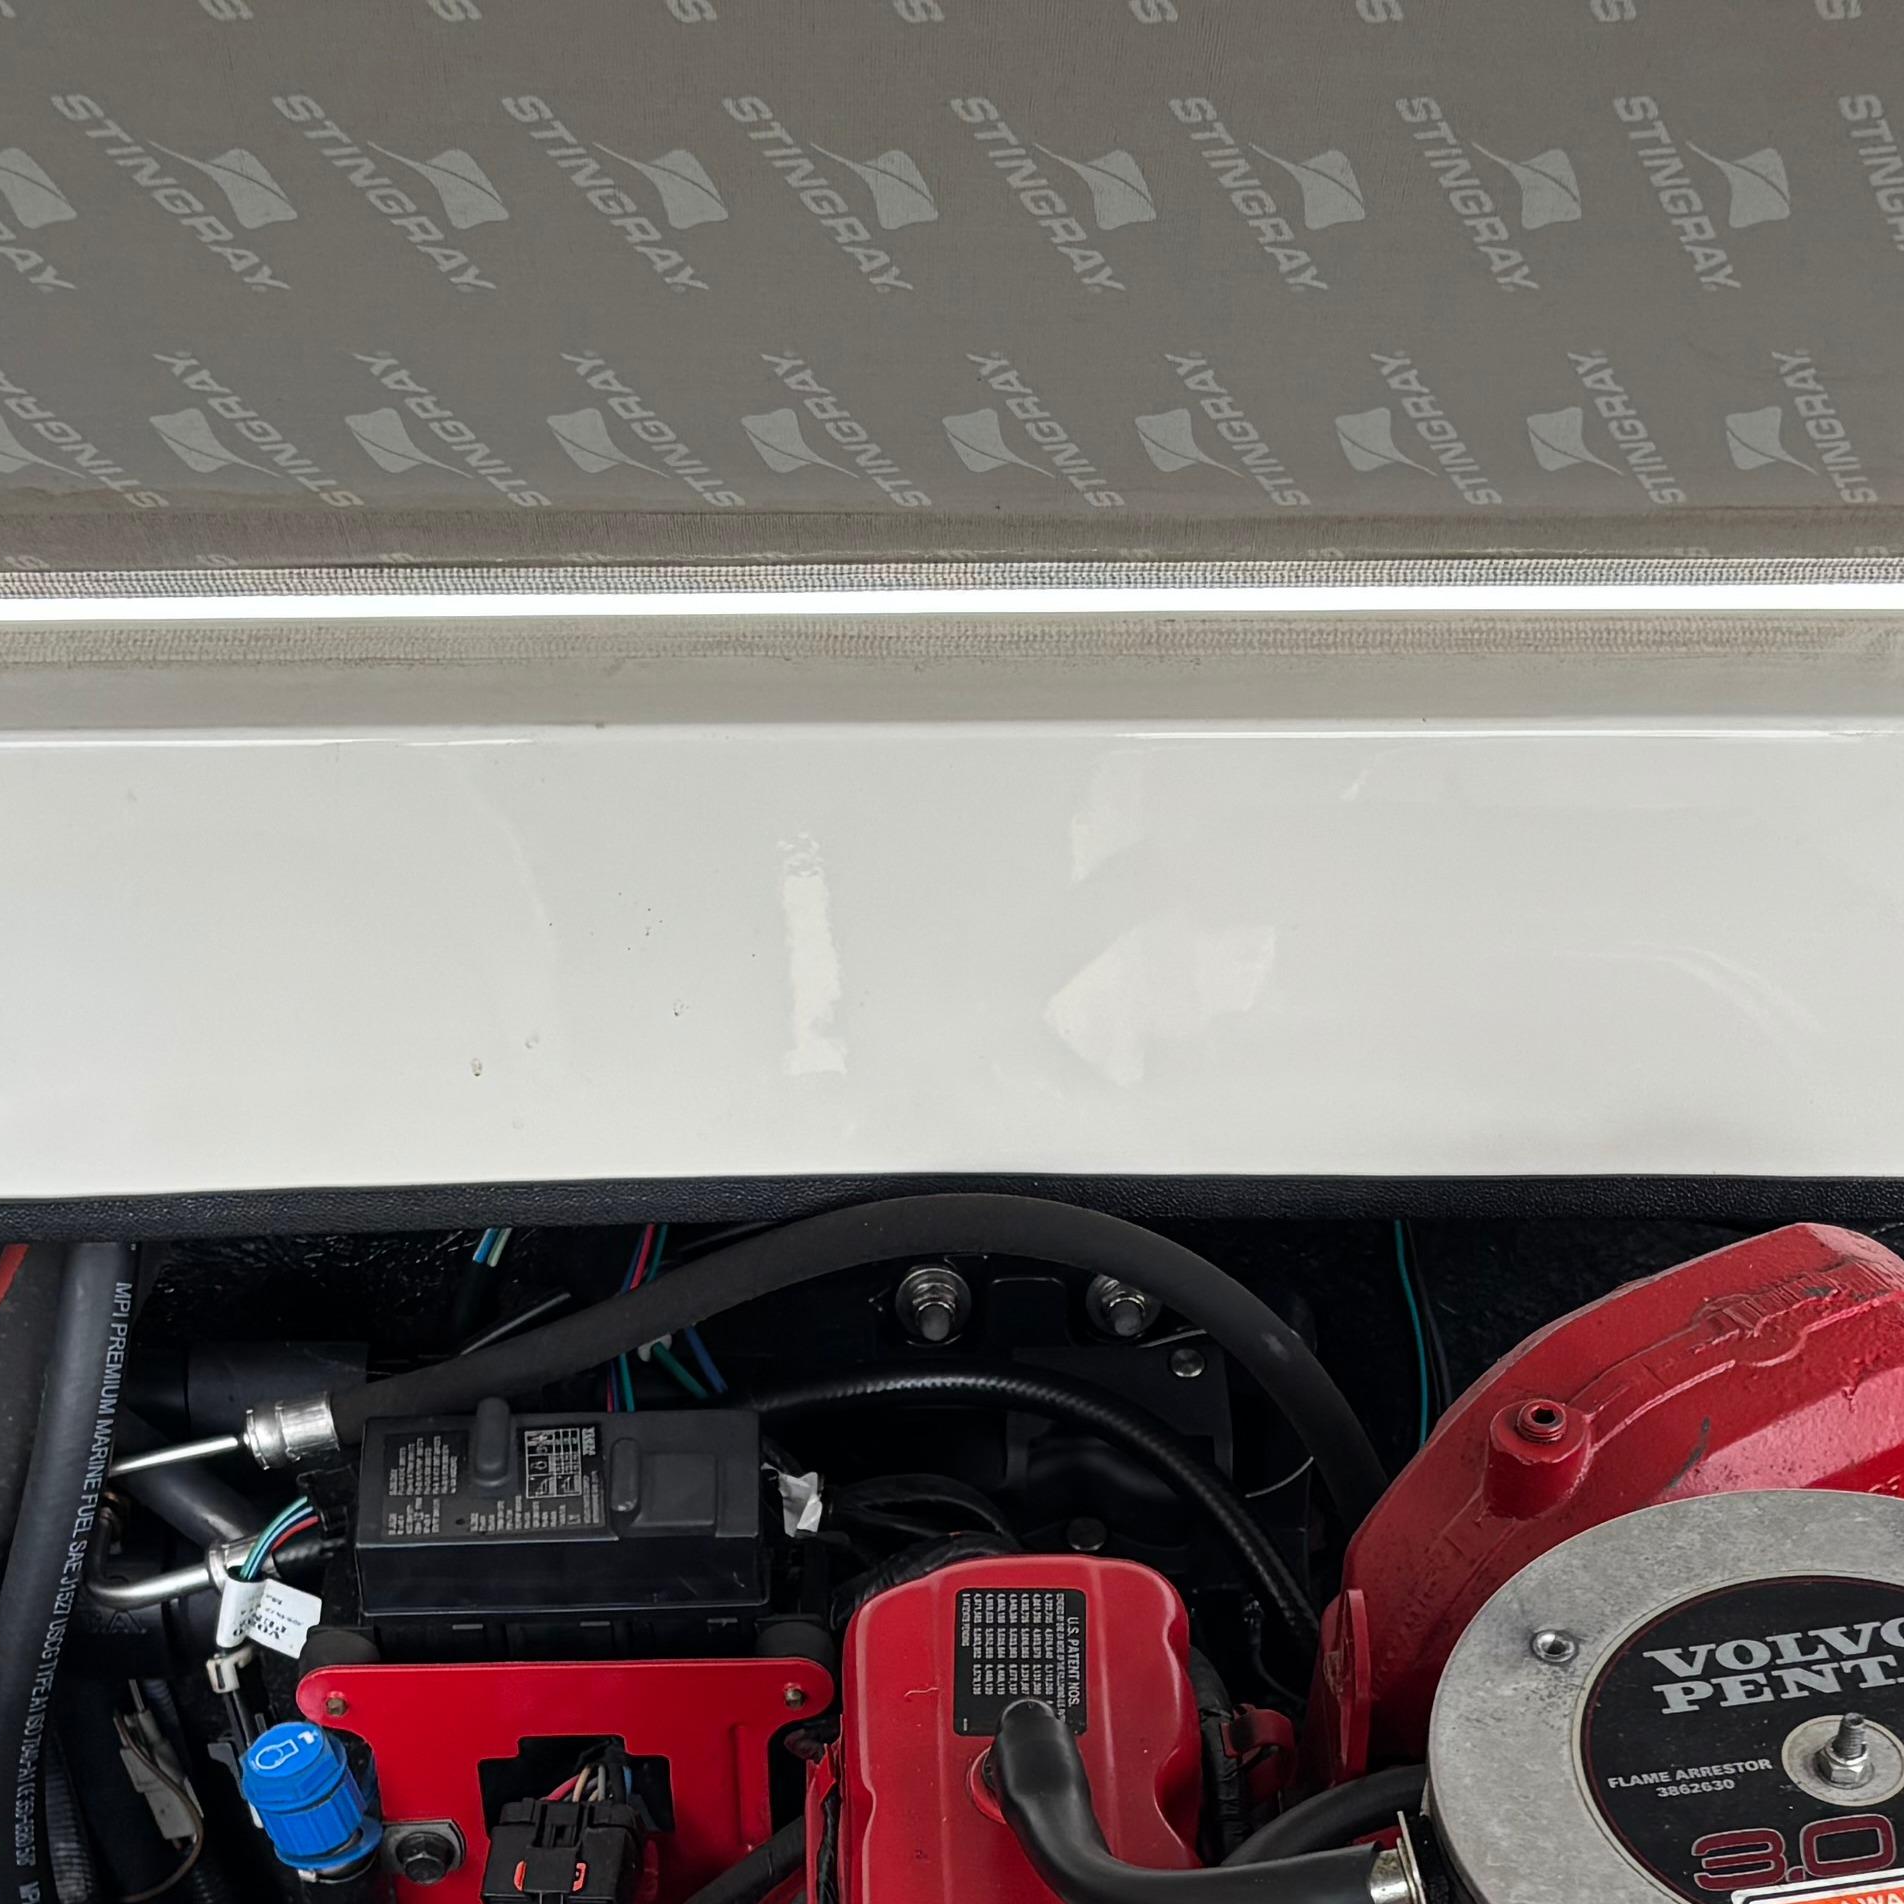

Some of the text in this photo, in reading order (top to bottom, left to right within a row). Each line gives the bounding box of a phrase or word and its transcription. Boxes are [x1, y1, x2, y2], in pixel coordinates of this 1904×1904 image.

[52, 93, 291, 292] STINGRAY
[271, 94, 496, 292] STINGRAY
[502, 94, 709, 292] STINGRAY
[722, 95, 913, 292] STINGRAY
[951, 96, 1126, 292] STINGRAY
[1169, 97, 1328, 292] STINGRAY
[1396, 96, 1540, 291] STINGRAY
[1613, 96, 1741, 291] STINGRAY
[153, 351, 364, 509] STINGRAY
[352, 350, 551, 508] STINGRAY
[560, 350, 745, 508] STINGRAY
[761, 350, 932, 508] STINGRAY
[966, 350, 1125, 508] STINGRAY
[1165, 350, 1311, 508] STINGRAY
[1370, 349, 1502, 506] STINGRAY
[1567, 349, 1687, 505] STINGRAY
[1771, 348, 1878, 504] STINGRAY
[32, 1282, 133, 1696] MPI PREMIUM MARINE FUEL SAE J1527 USCG TYPE
[1067, 1616, 1080, 1707] U.S. PATENT NOS.
[1608, 1758, 1773, 1788] FLAME ARRESTOR
[1656, 1779, 1735, 1797] 3862630
